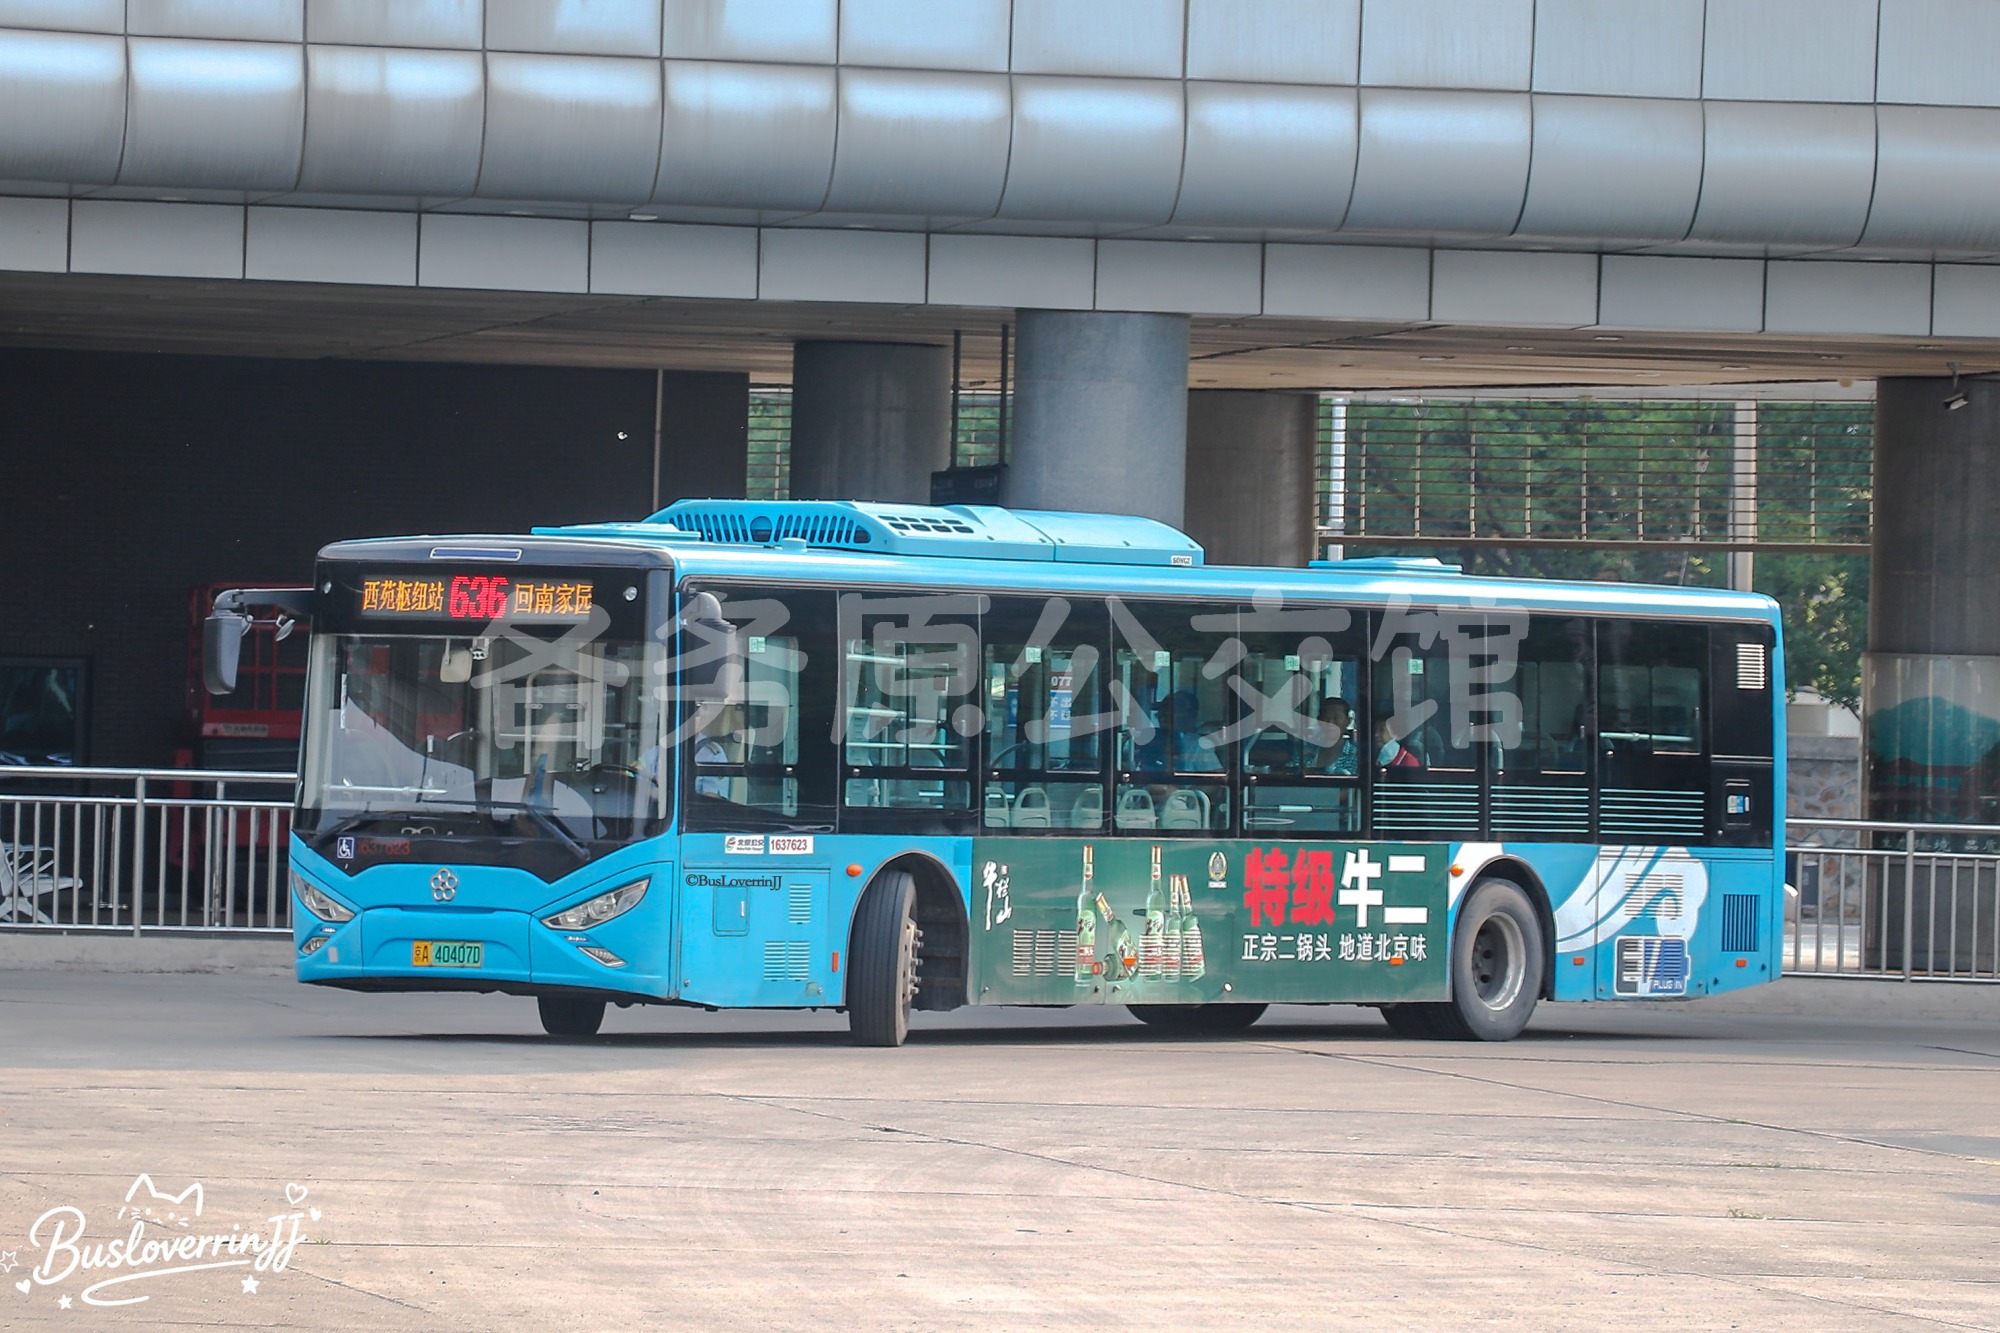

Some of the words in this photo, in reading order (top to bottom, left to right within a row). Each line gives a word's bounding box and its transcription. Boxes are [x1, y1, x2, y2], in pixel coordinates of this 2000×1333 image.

[362, 580, 444, 612] 西苑枢纽站
[449, 576, 509, 618] 636
[770, 839, 808, 851] 1637623
[1243, 847, 1428, 928] 特级牛二
[1241, 932, 1332, 962] 正宗二锅头
[1338, 932, 1428, 962] 地道北京味
[1653, 980, 1673, 990] PLUG
[1674, 980, 1683, 990] IN
